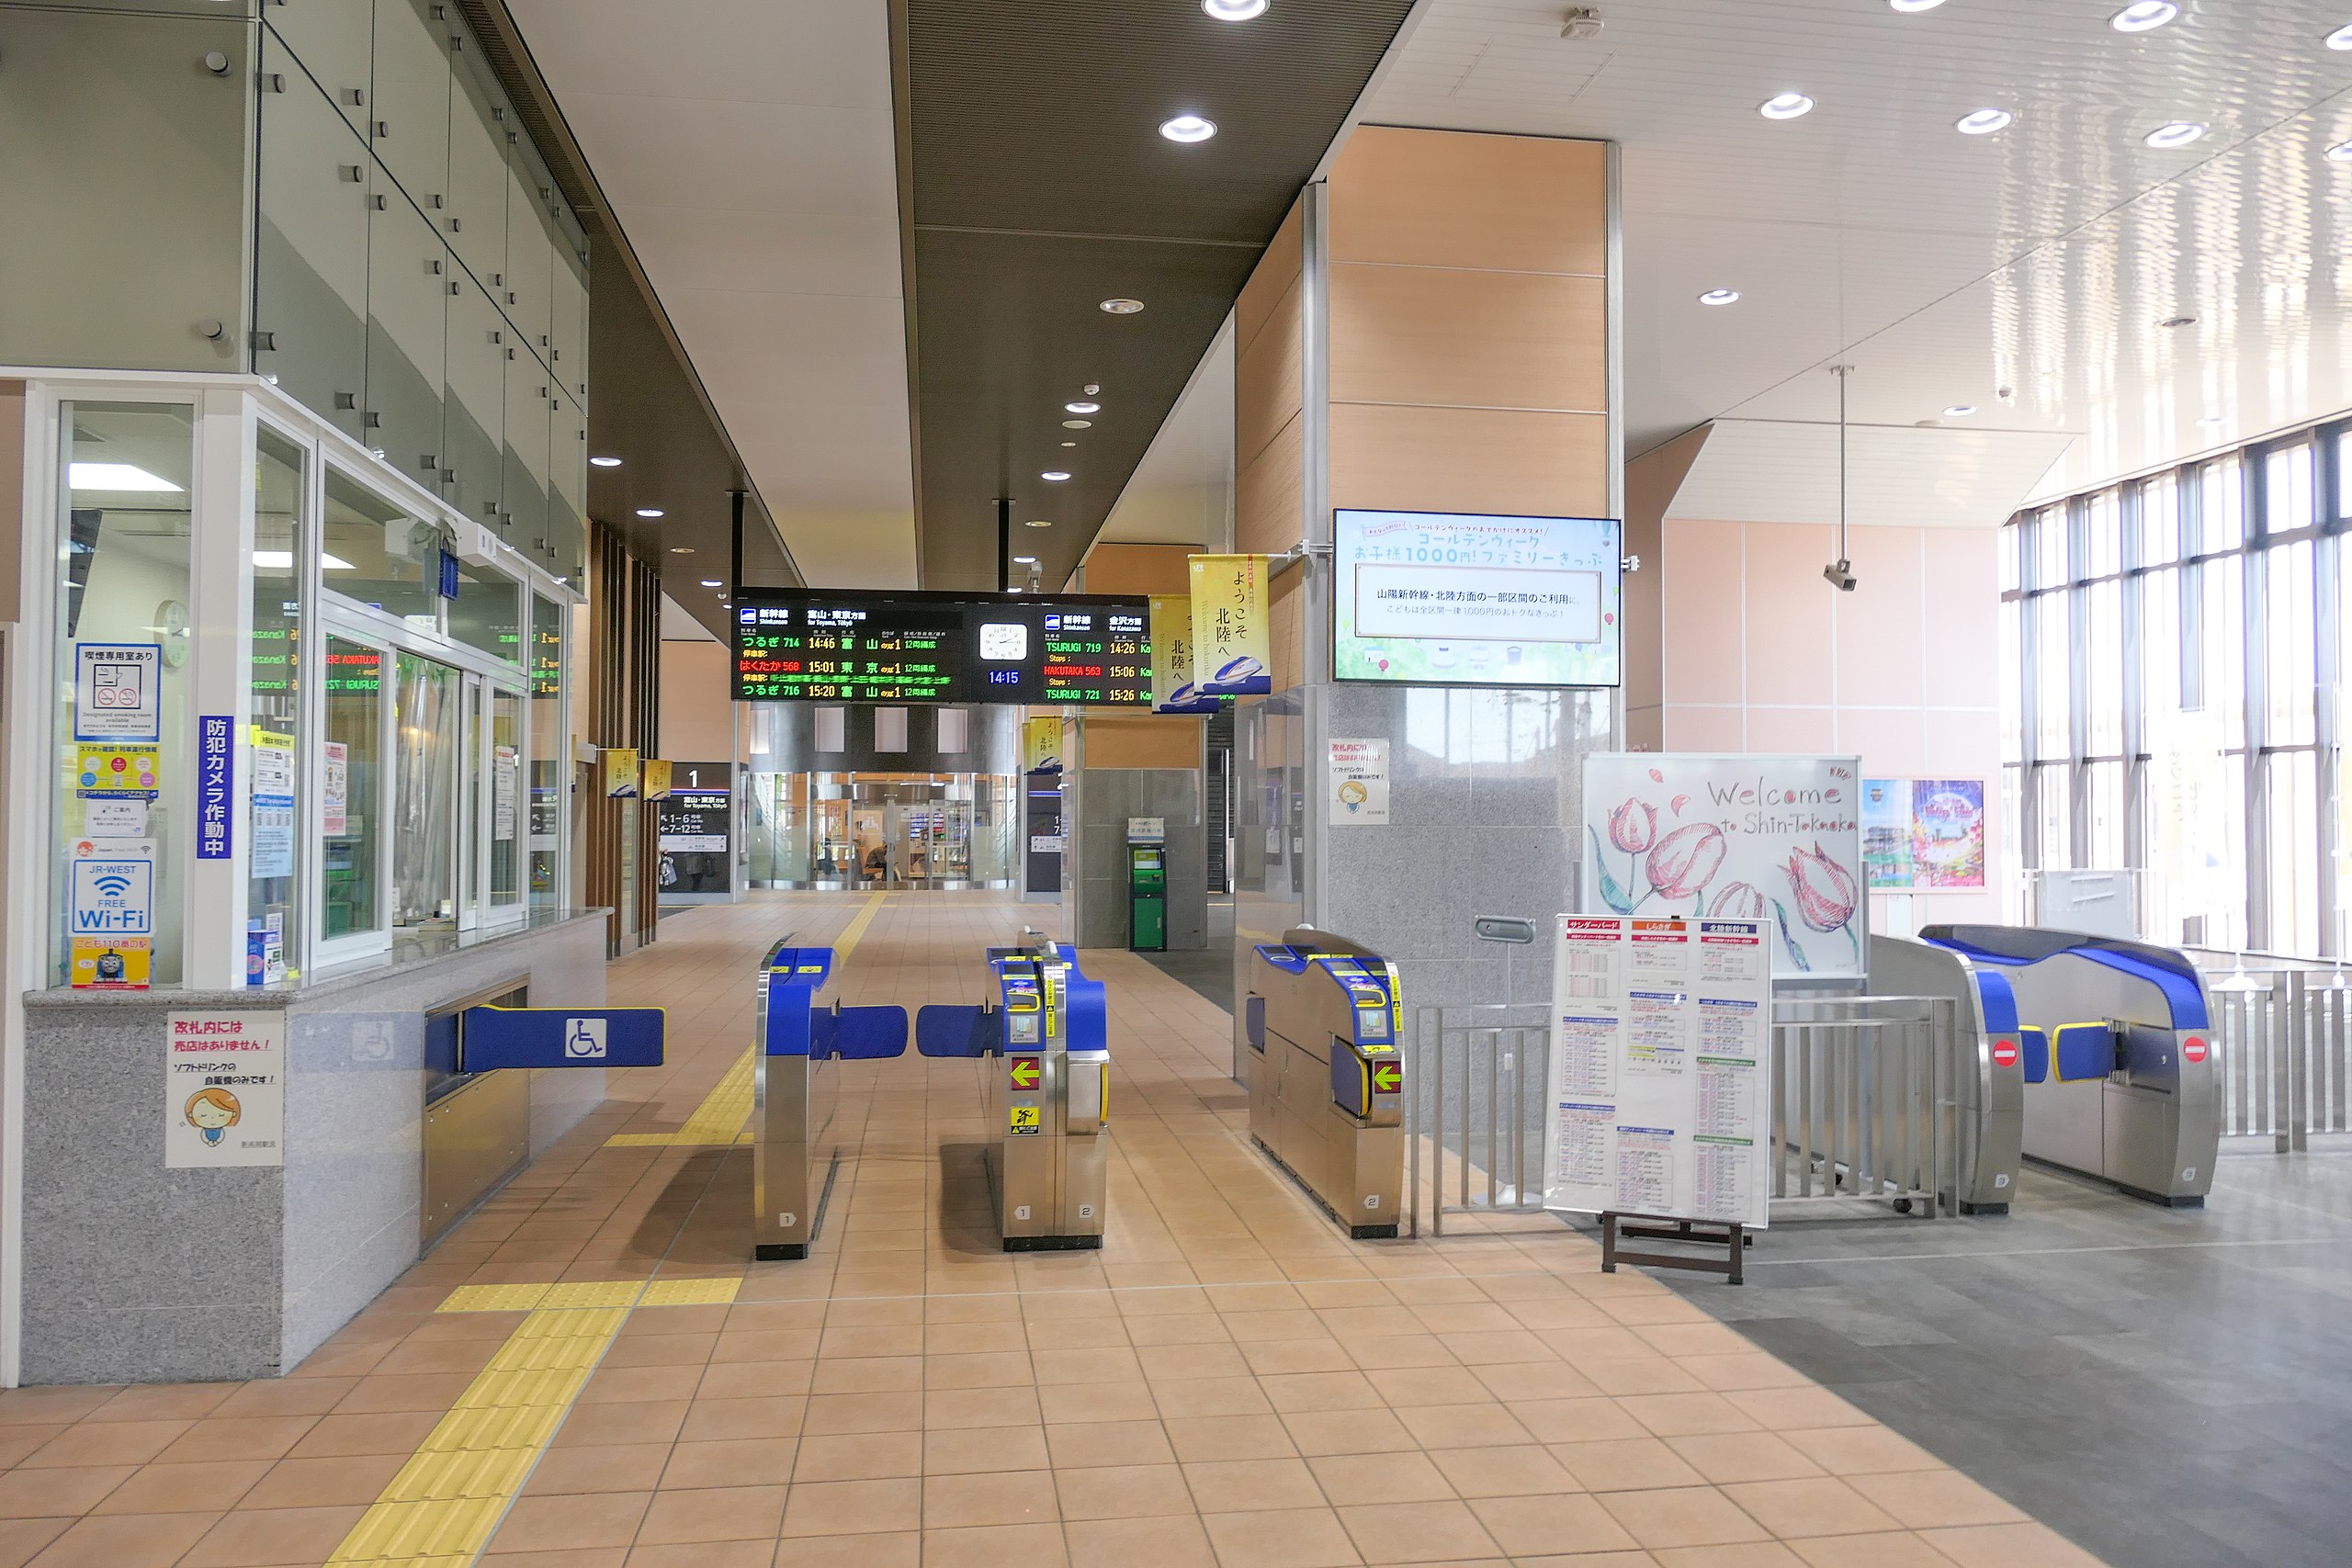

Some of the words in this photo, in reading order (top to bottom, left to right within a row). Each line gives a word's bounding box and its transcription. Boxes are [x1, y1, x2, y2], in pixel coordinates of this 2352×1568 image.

[1234, 571, 1247, 639] ようこそ
[760, 609, 788, 618] 新幹線
[808, 610, 866, 620] 富山・東京方面
[1064, 615, 1091, 625] 新幹線
[1109, 615, 1142, 626] 金沢方面
[1216, 608, 1231, 656] 北陸へ
[742, 637, 780, 649] つるぎ
[783, 637, 800, 649] 714
[808, 637, 835, 649] 14:46
[1046, 643, 1081, 652] TSURUGI
[1085, 643, 1102, 653] 719
[1110, 643, 1135, 654] 14:26
[85, 651, 153, 660] 喫煙専用室あり
[1171, 639, 1184, 681] 北陸へ
[740, 660, 780, 672] はくたか
[783, 661, 800, 672] 568
[808, 660, 835, 673] 15:01
[1044, 666, 1083, 676] HAKUTAKA
[1085, 666, 1102, 676] 563
[1110, 666, 1135, 677] 15:06
[989, 671, 1020, 684] 14:15
[1049, 678, 1066, 686] Stops
[742, 686, 780, 696] つるぎ
[783, 687, 800, 696] 716
[808, 685, 835, 697] 15:20
[1046, 690, 1081, 699] TSURUGI
[1085, 690, 1100, 699] 721
[1110, 690, 1135, 701] 15:26
[689, 770, 697, 787] 1
[205, 719, 227, 856] 防犯カメラ作動中
[1707, 775, 1841, 807] Welcome
[1721, 818, 1737, 833] to
[1743, 811, 1858, 834] Shin-Takaoka
[90, 865, 136, 874] JR-WEST
[79, 910, 143, 928] Wi-Fi
[1569, 920, 1618, 929] サンダーバード
[1709, 924, 1748, 932] 北陸新幹線
[76, 940, 147, 948] こども110番の駅
[175, 1021, 243, 1034] 改札内には
[175, 1040, 270, 1052] 売店はありません！
[175, 1063, 236, 1072] ソフトドリンクの
[205, 1076, 275, 1085] 自販機のみです！
[785, 1215, 789, 1224] 1
